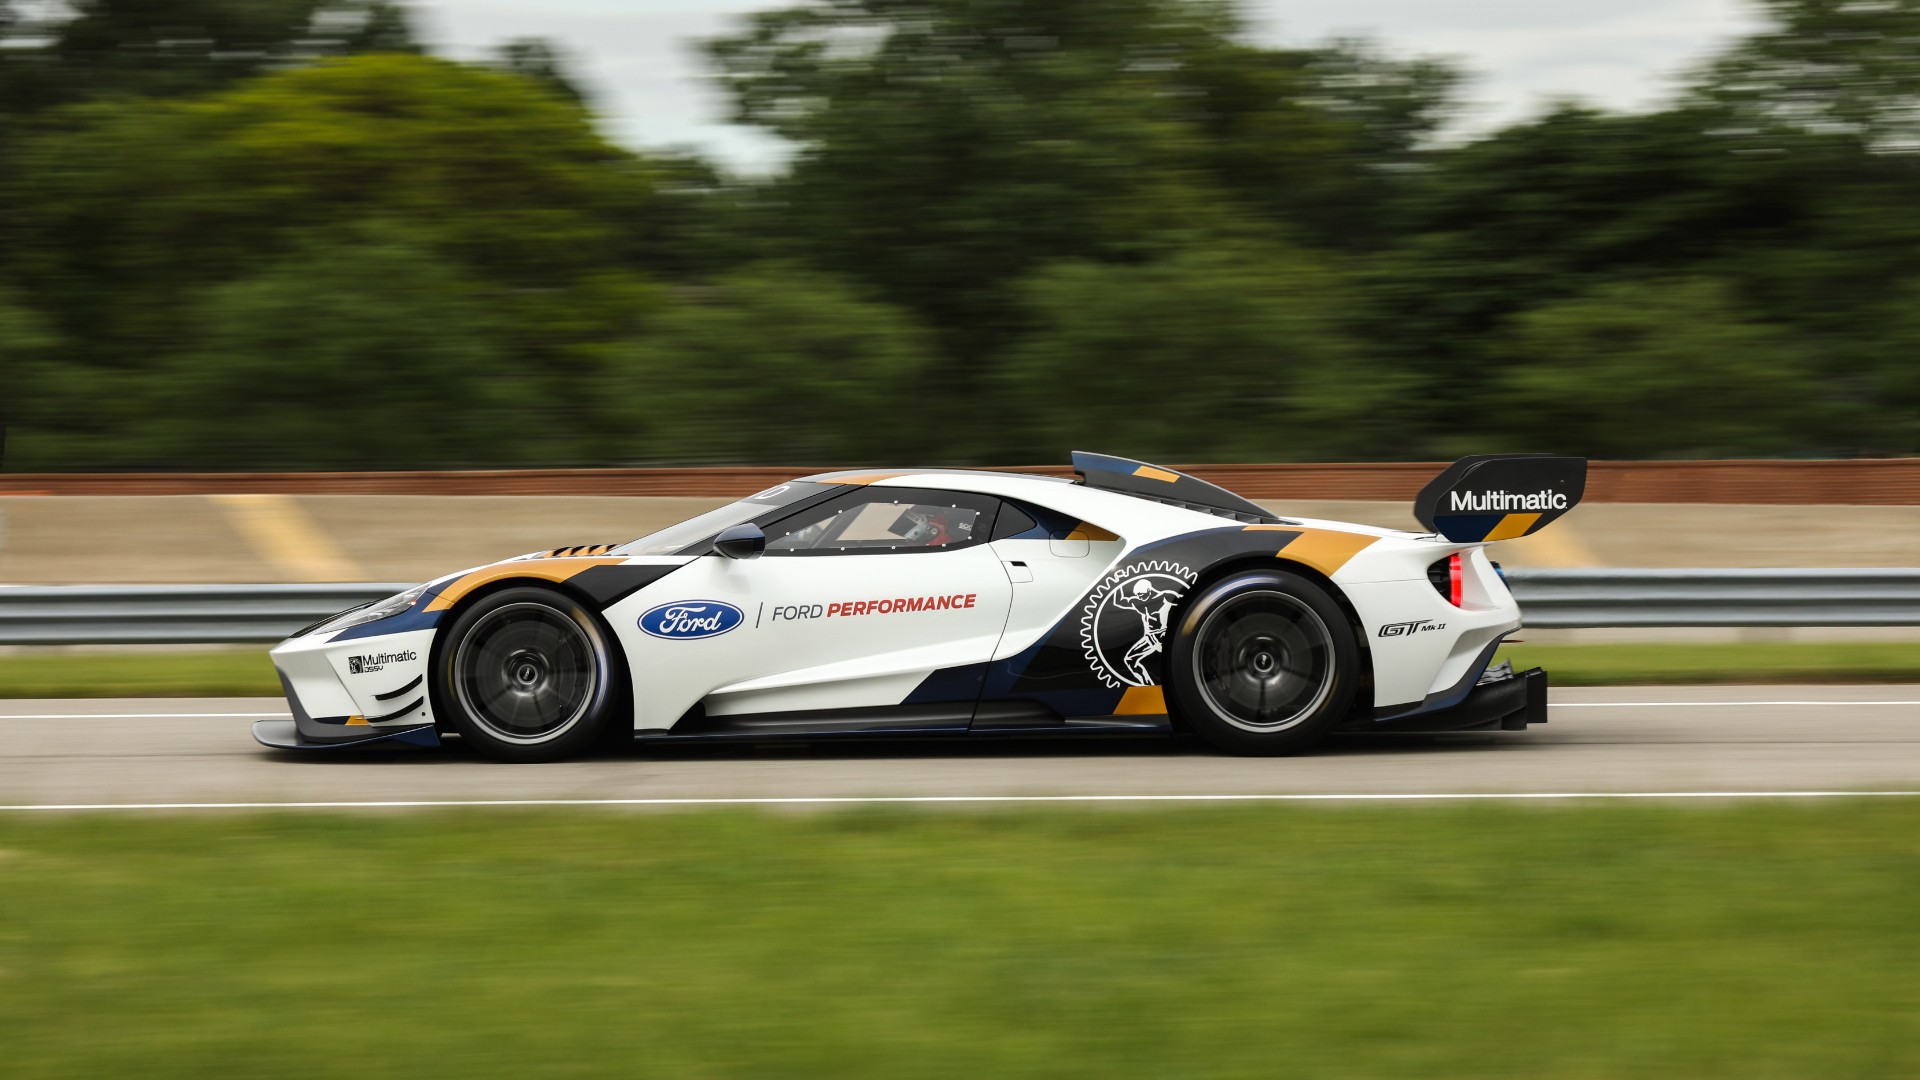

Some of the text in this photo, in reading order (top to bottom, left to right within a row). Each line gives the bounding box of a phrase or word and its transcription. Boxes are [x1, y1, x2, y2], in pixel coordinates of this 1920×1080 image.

[1451, 489, 1567, 511] Multimatic
[772, 594, 976, 621] FORD PERFORMANCE
[659, 606, 722, 633] Ford
[1378, 619, 1433, 637] GT
[362, 650, 417, 666] Multimatic
